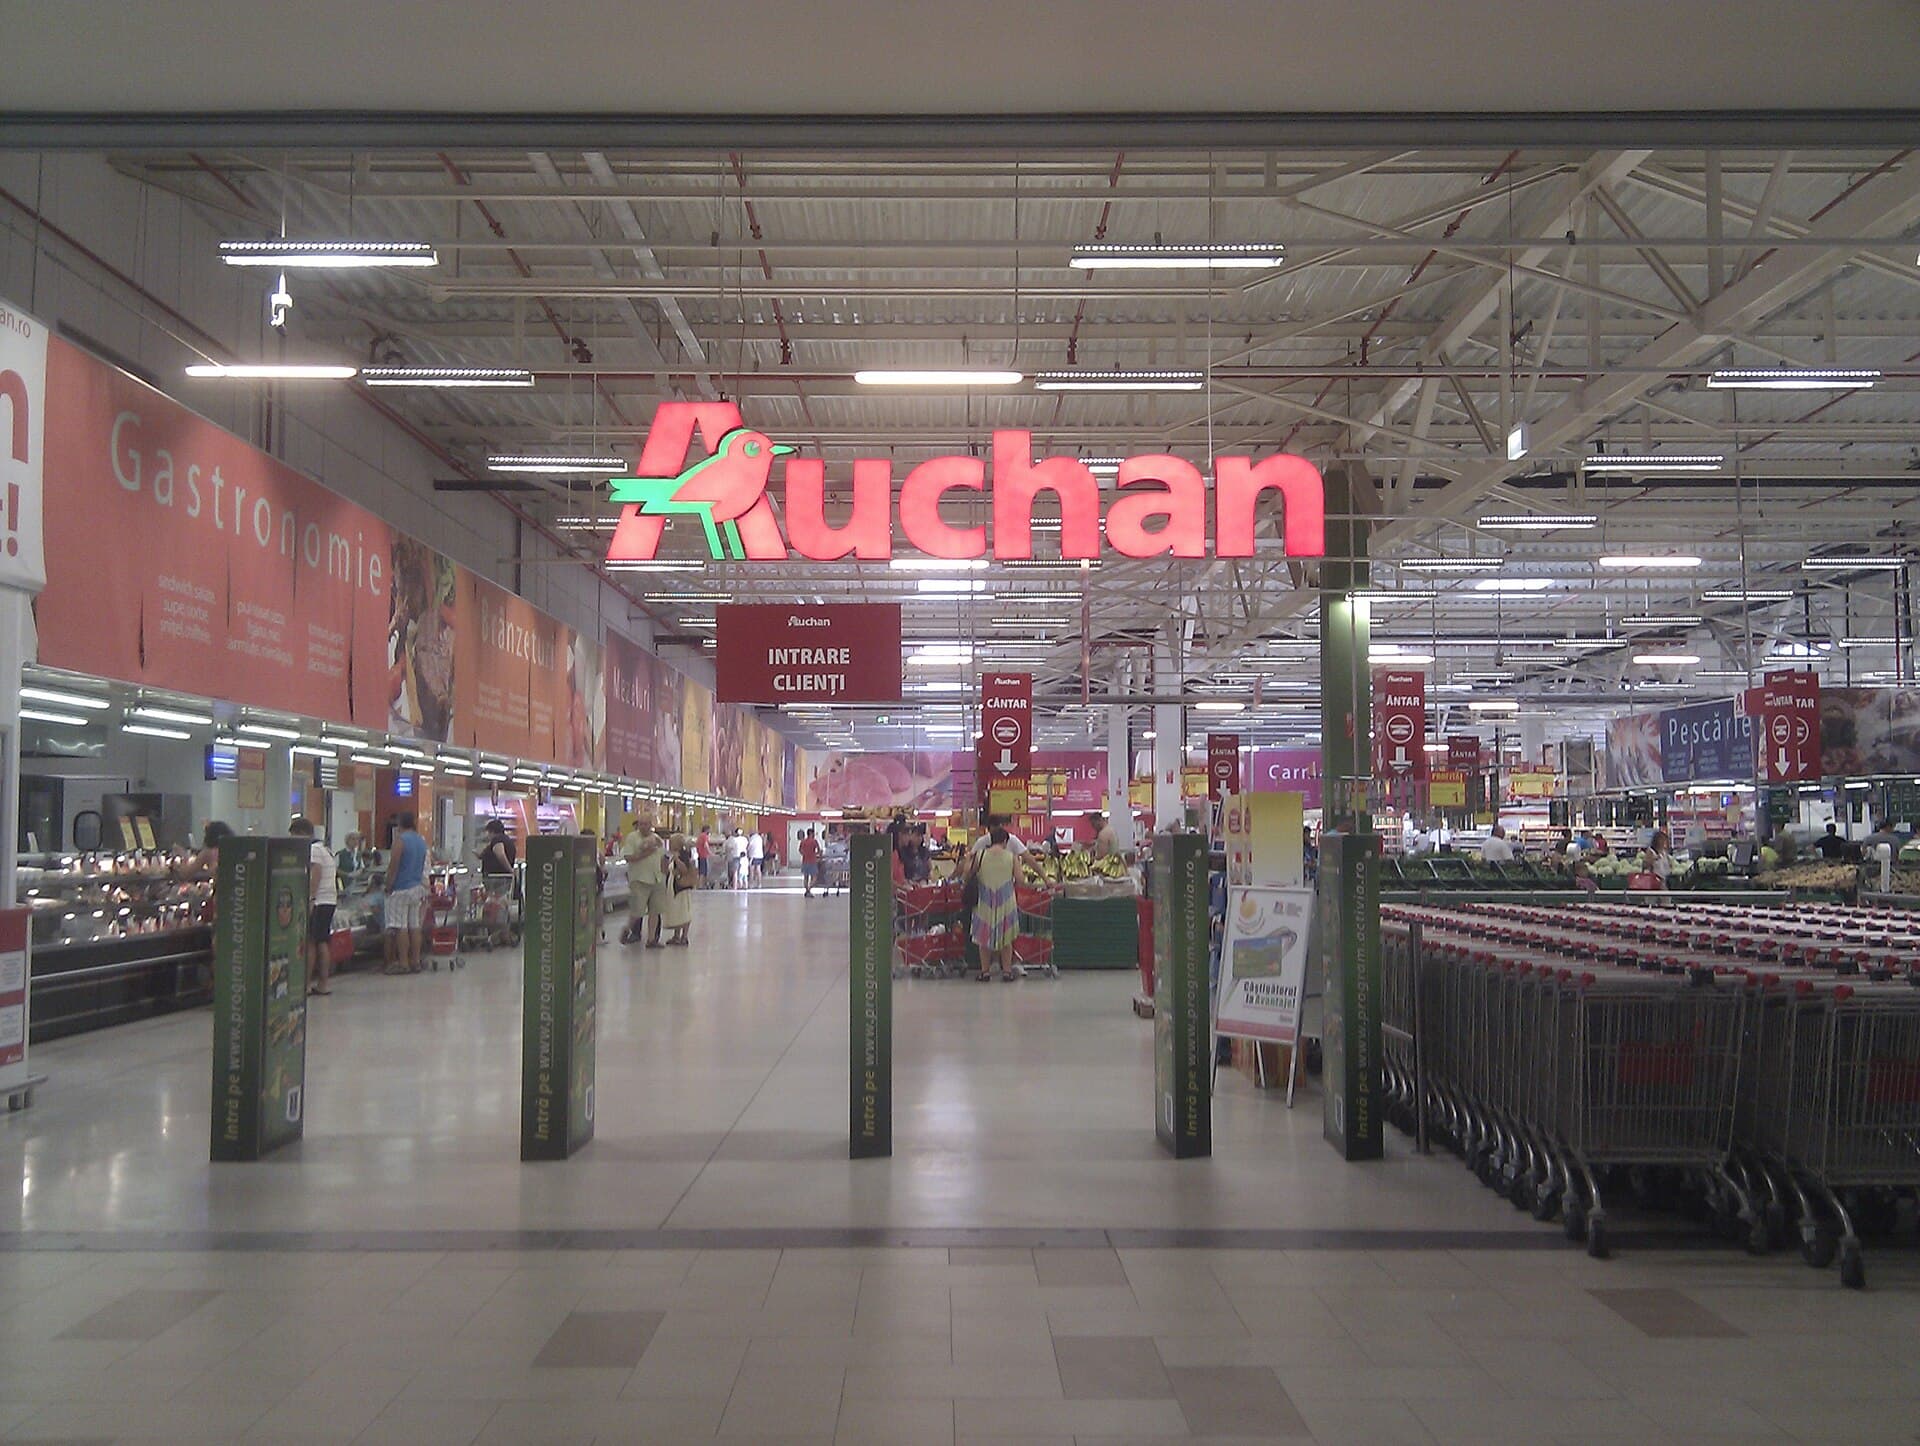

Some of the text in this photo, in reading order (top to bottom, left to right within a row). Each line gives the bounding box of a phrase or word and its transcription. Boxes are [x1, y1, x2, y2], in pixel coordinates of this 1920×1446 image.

[606, 402, 1326, 561] Auchan
[110, 410, 383, 597] Gastronomie
[787, 615, 831, 627] Auchan
[768, 648, 850, 665] INTRARE
[994, 677, 1021, 686] Auchan
[1387, 675, 1413, 683] Auchan
[987, 697, 1027, 709] CÂNTAR
[1668, 713, 1750, 746] Pescărie
[230, 864, 246, 1068] www.program.activia.ro
[540, 862, 554, 1068] www.program.activia.ro
[863, 860, 877, 1065] www.program.activia.ro
[1185, 861, 1198, 1066] www.program.activia.ro
[1355, 862, 1368, 1066] www.program.activia.ro
[228, 1073, 242, 1096] pe
[538, 1071, 552, 1095] pe
[865, 1070, 877, 1093] pe
[1188, 1070, 1198, 1093] pe
[1359, 1071, 1370, 1093] pe
